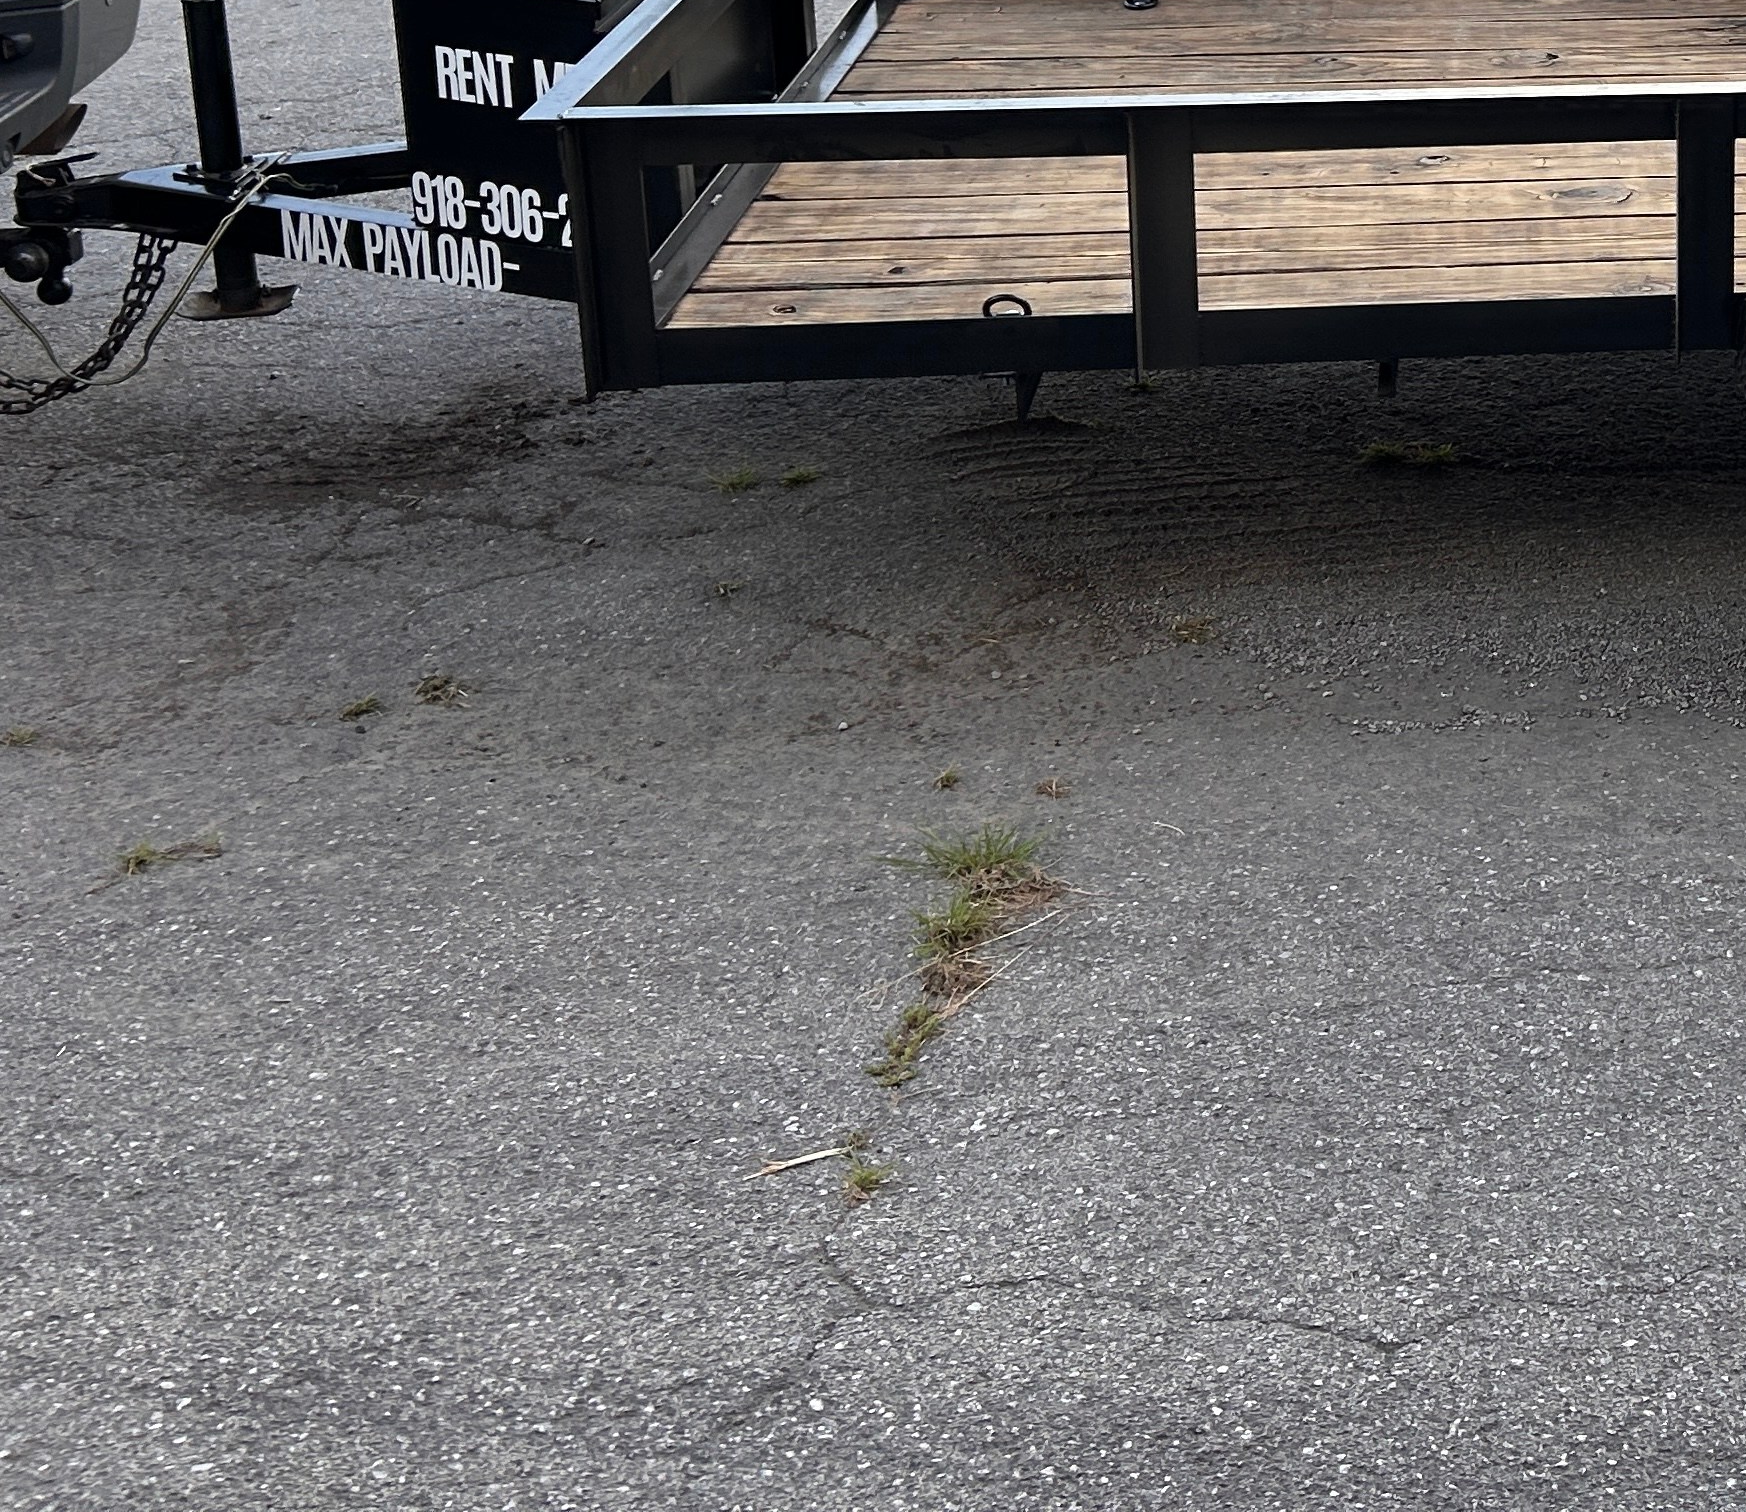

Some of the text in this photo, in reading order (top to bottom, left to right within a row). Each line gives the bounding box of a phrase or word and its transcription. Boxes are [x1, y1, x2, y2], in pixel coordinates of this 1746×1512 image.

[434, 45, 579, 109] RENT M
[281, 208, 353, 269] MAX
